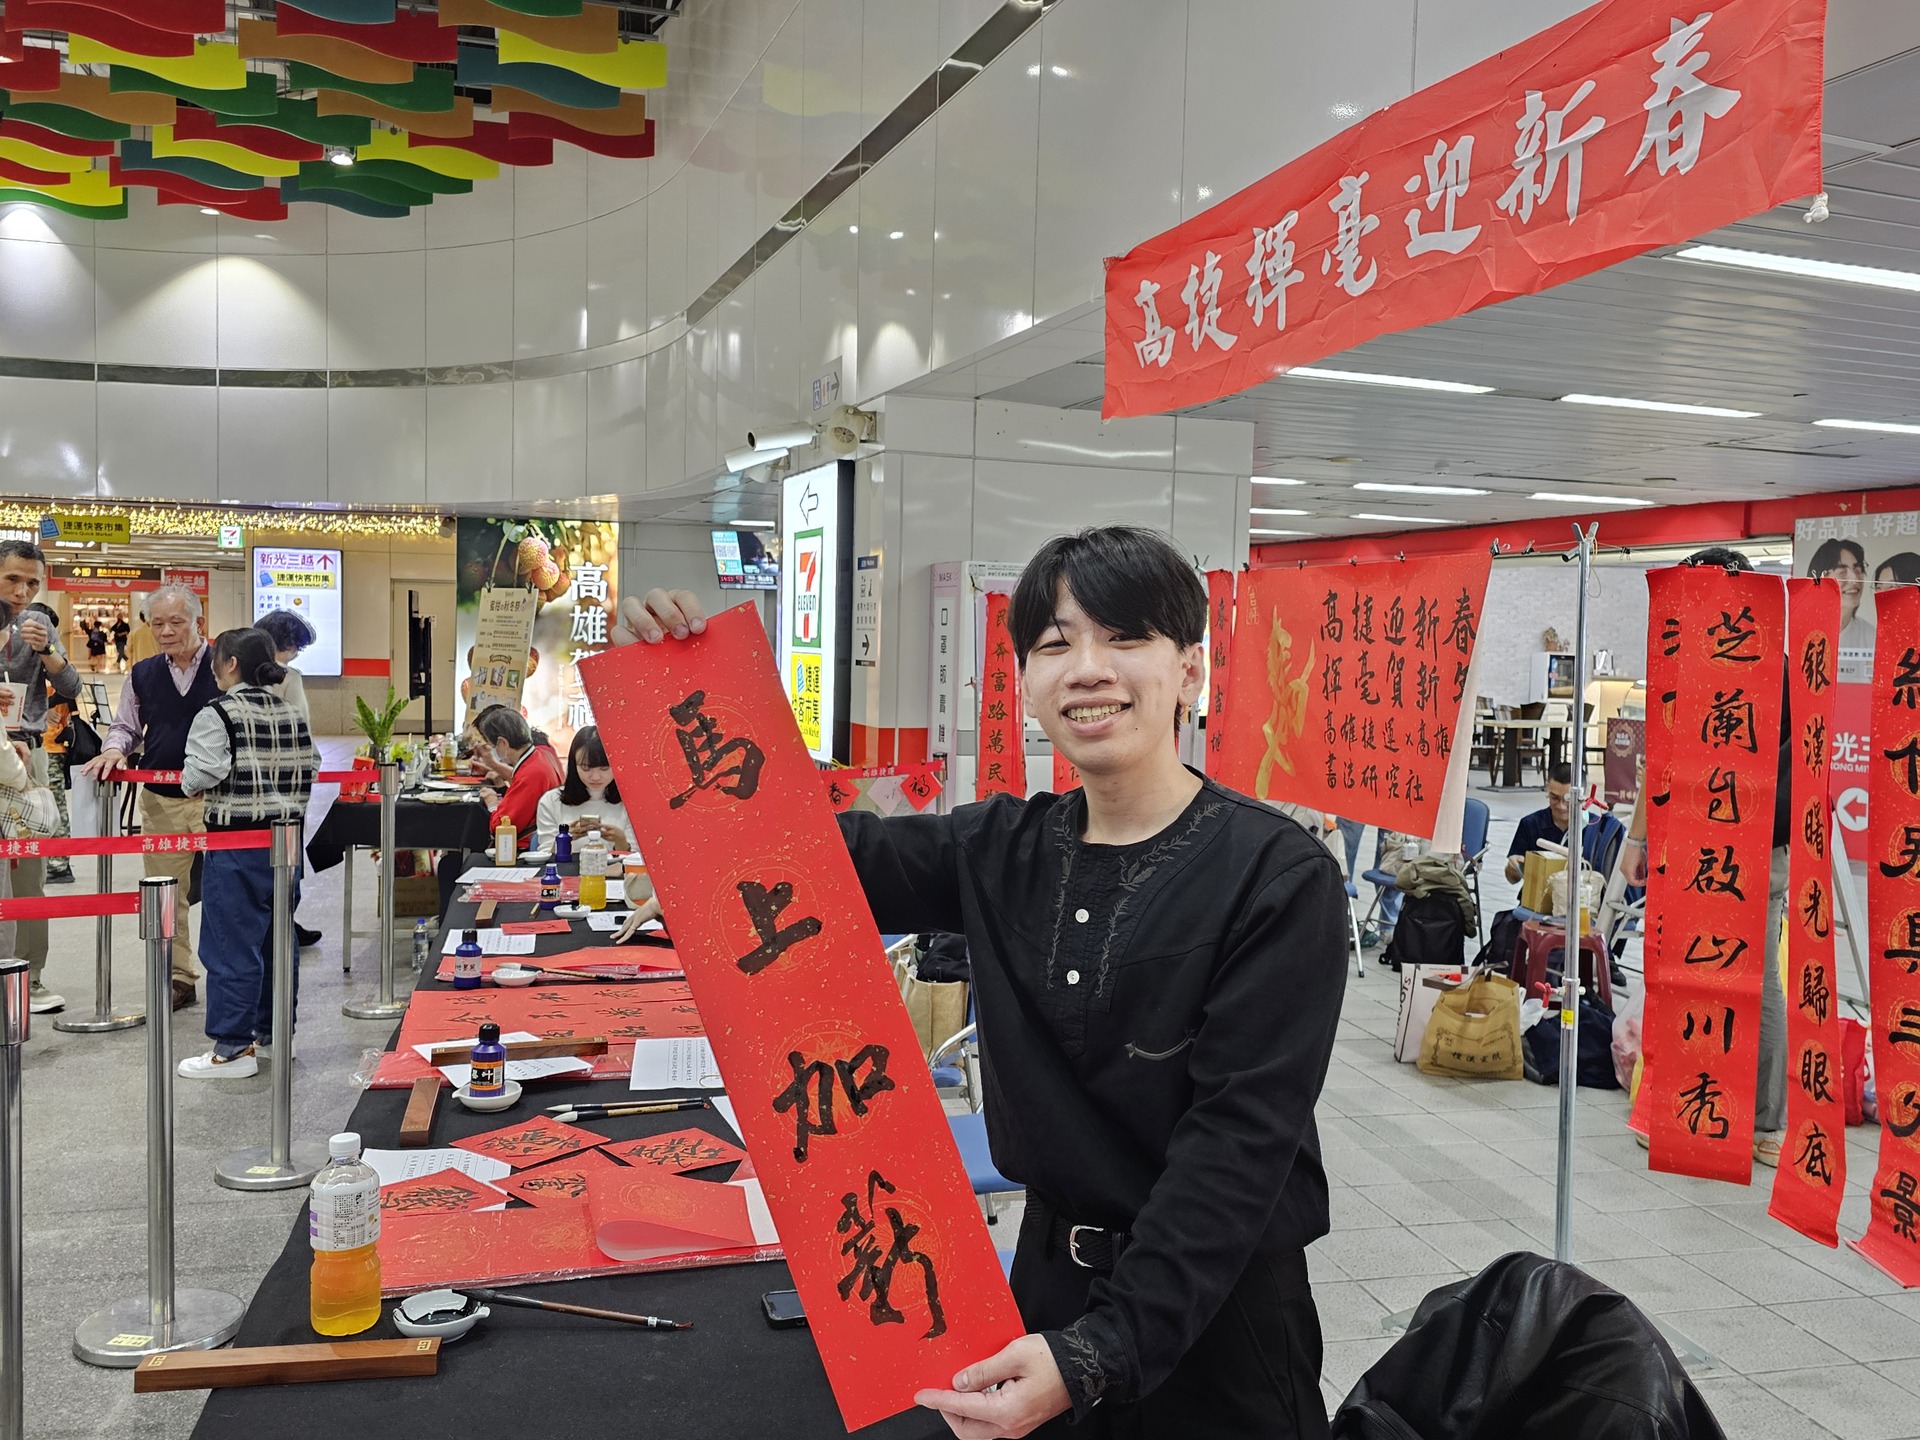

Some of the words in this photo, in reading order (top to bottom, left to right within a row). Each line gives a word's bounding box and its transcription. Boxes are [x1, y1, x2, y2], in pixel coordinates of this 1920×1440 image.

[1133, 12, 1742, 369] 高捷揮毫迎新春
[63, 520, 124, 532] 捷運快客市集
[1796, 511, 1920, 542] 好品質、好超
[260, 552, 314, 566] 新光三越
[276, 573, 330, 583] 捷運快客市集
[1320, 587, 1476, 661] 高捷迎新春
[569, 562, 608, 731] 高雄
[983, 609, 1009, 801] 民奔富路萬民
[862, 767, 896, 778] 高雄捷運
[1830, 762, 1854, 773] ONG
[153, 770, 182, 783] 高雄
[0, 841, 40, 856] 捷運
[142, 836, 209, 852] 高雄捷運
